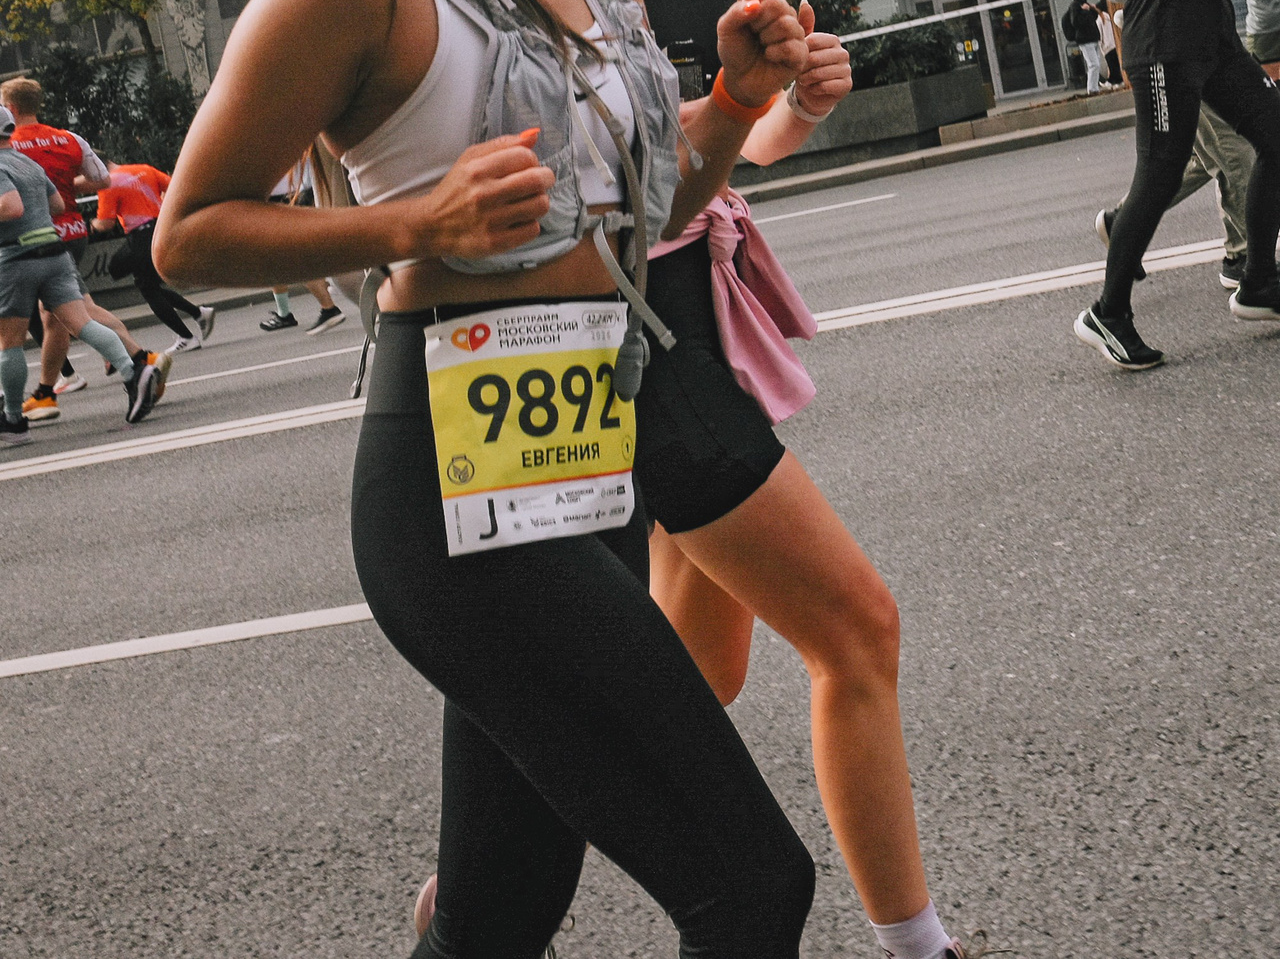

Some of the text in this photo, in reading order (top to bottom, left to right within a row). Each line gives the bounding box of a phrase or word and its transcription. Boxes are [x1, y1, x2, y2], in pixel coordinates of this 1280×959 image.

[11, 139, 34, 150] Run
[35, 137, 51, 148] for
[496, 312, 560, 326] СБЕРПРАЙМ
[497, 321, 579, 337] МОСКОВСКИЙ
[499, 333, 561, 349] МАРАФОН
[467, 362, 621, 444] 9892
[521, 442, 601, 469] ЕВГЕНИЯ
[479, 498, 499, 540] J
